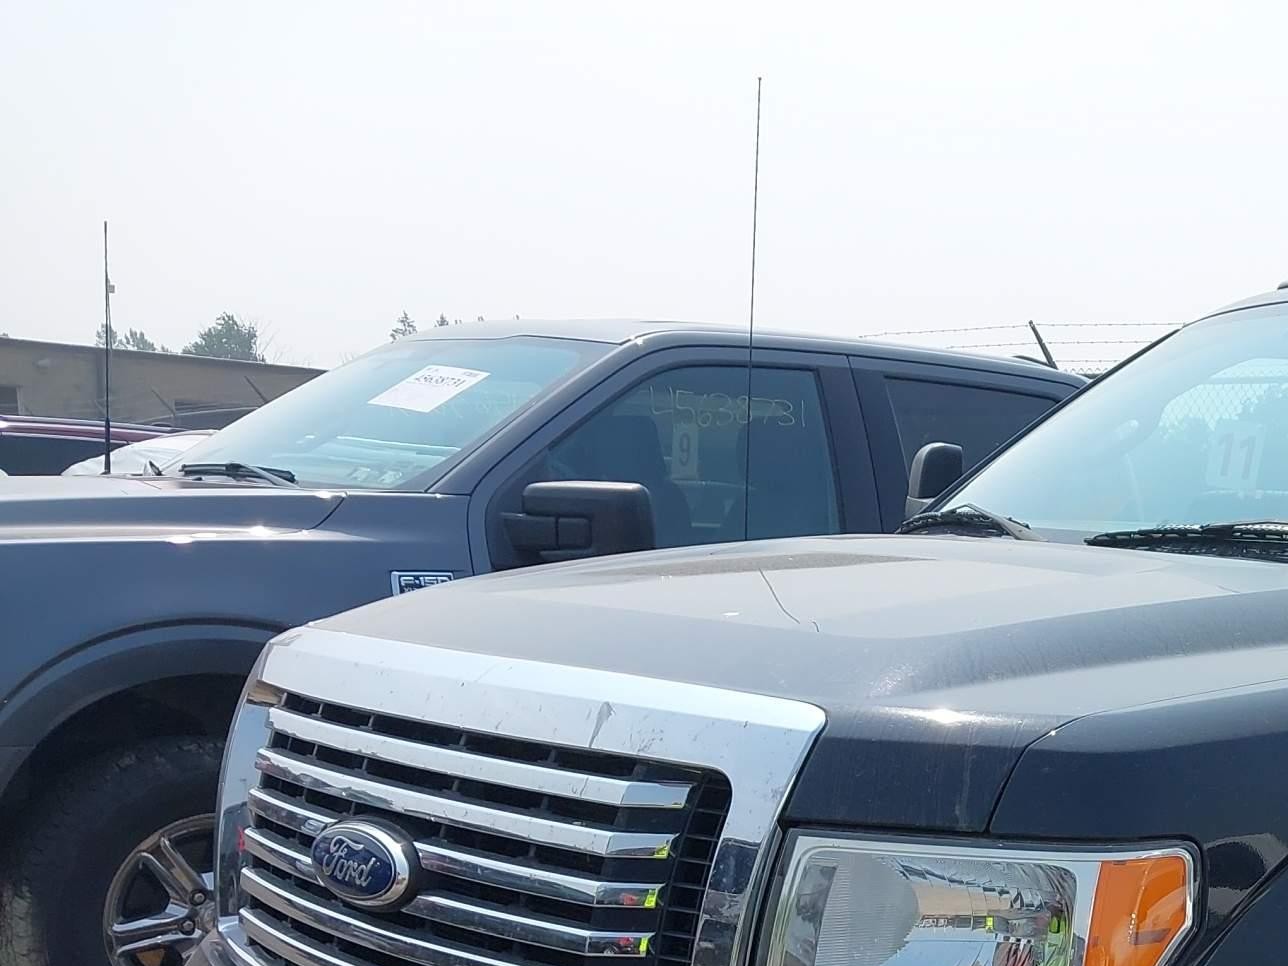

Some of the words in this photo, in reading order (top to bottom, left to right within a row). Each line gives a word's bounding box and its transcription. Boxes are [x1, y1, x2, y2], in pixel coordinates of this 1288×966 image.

[650, 385, 806, 428] 45638731
[1218, 432, 1257, 480] 11
[322, 835, 375, 888] Ford
